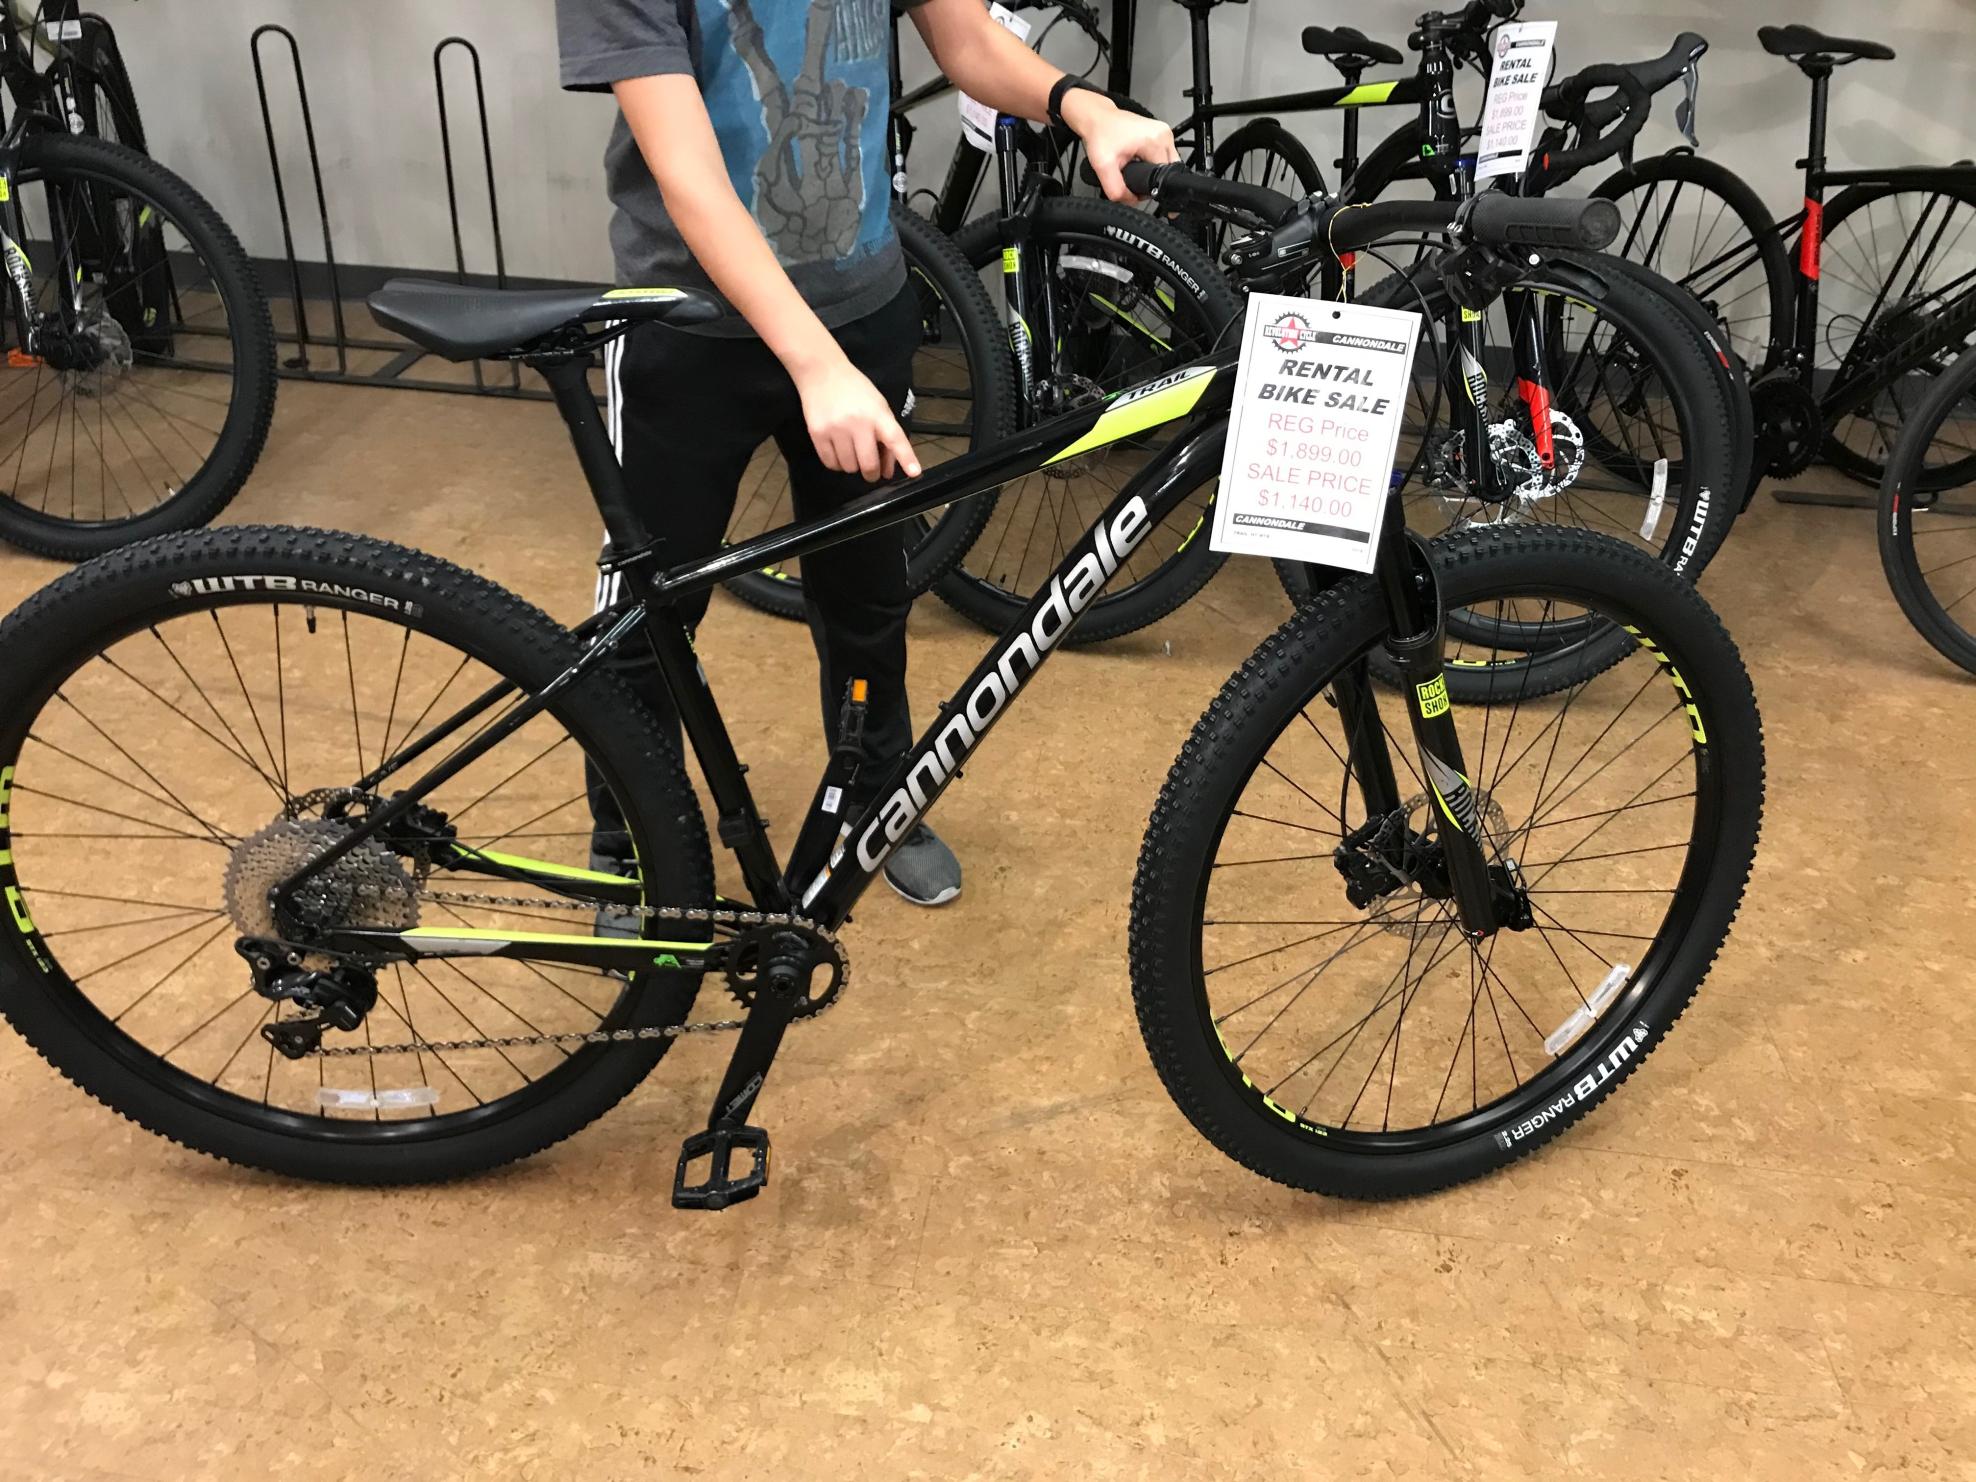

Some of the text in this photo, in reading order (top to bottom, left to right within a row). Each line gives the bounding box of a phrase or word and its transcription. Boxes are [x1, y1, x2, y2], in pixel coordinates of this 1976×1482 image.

[1500, 58, 1532, 70] RENTAL
[1493, 73, 1538, 88] BIKE SALE
[1115, 228, 1200, 293] WTB RANGER
[1332, 334, 1405, 353] CANNONDALE
[1128, 370, 1191, 400] TRAIL
[1278, 358, 1374, 386] RENTAL
[1258, 383, 1390, 415] BIKE SALE
[1268, 413, 1369, 442] REG Price
[1247, 463, 1373, 495] SALE PRICE
[1235, 514, 1306, 531] CANNONDALE
[1682, 500, 1709, 556] WTB
[191, 575, 297, 595] WTB
[301, 580, 399, 610] RANGER
[856, 495, 1153, 873] cannondale
[1511, 1036, 1638, 1140] WTB RANGER
